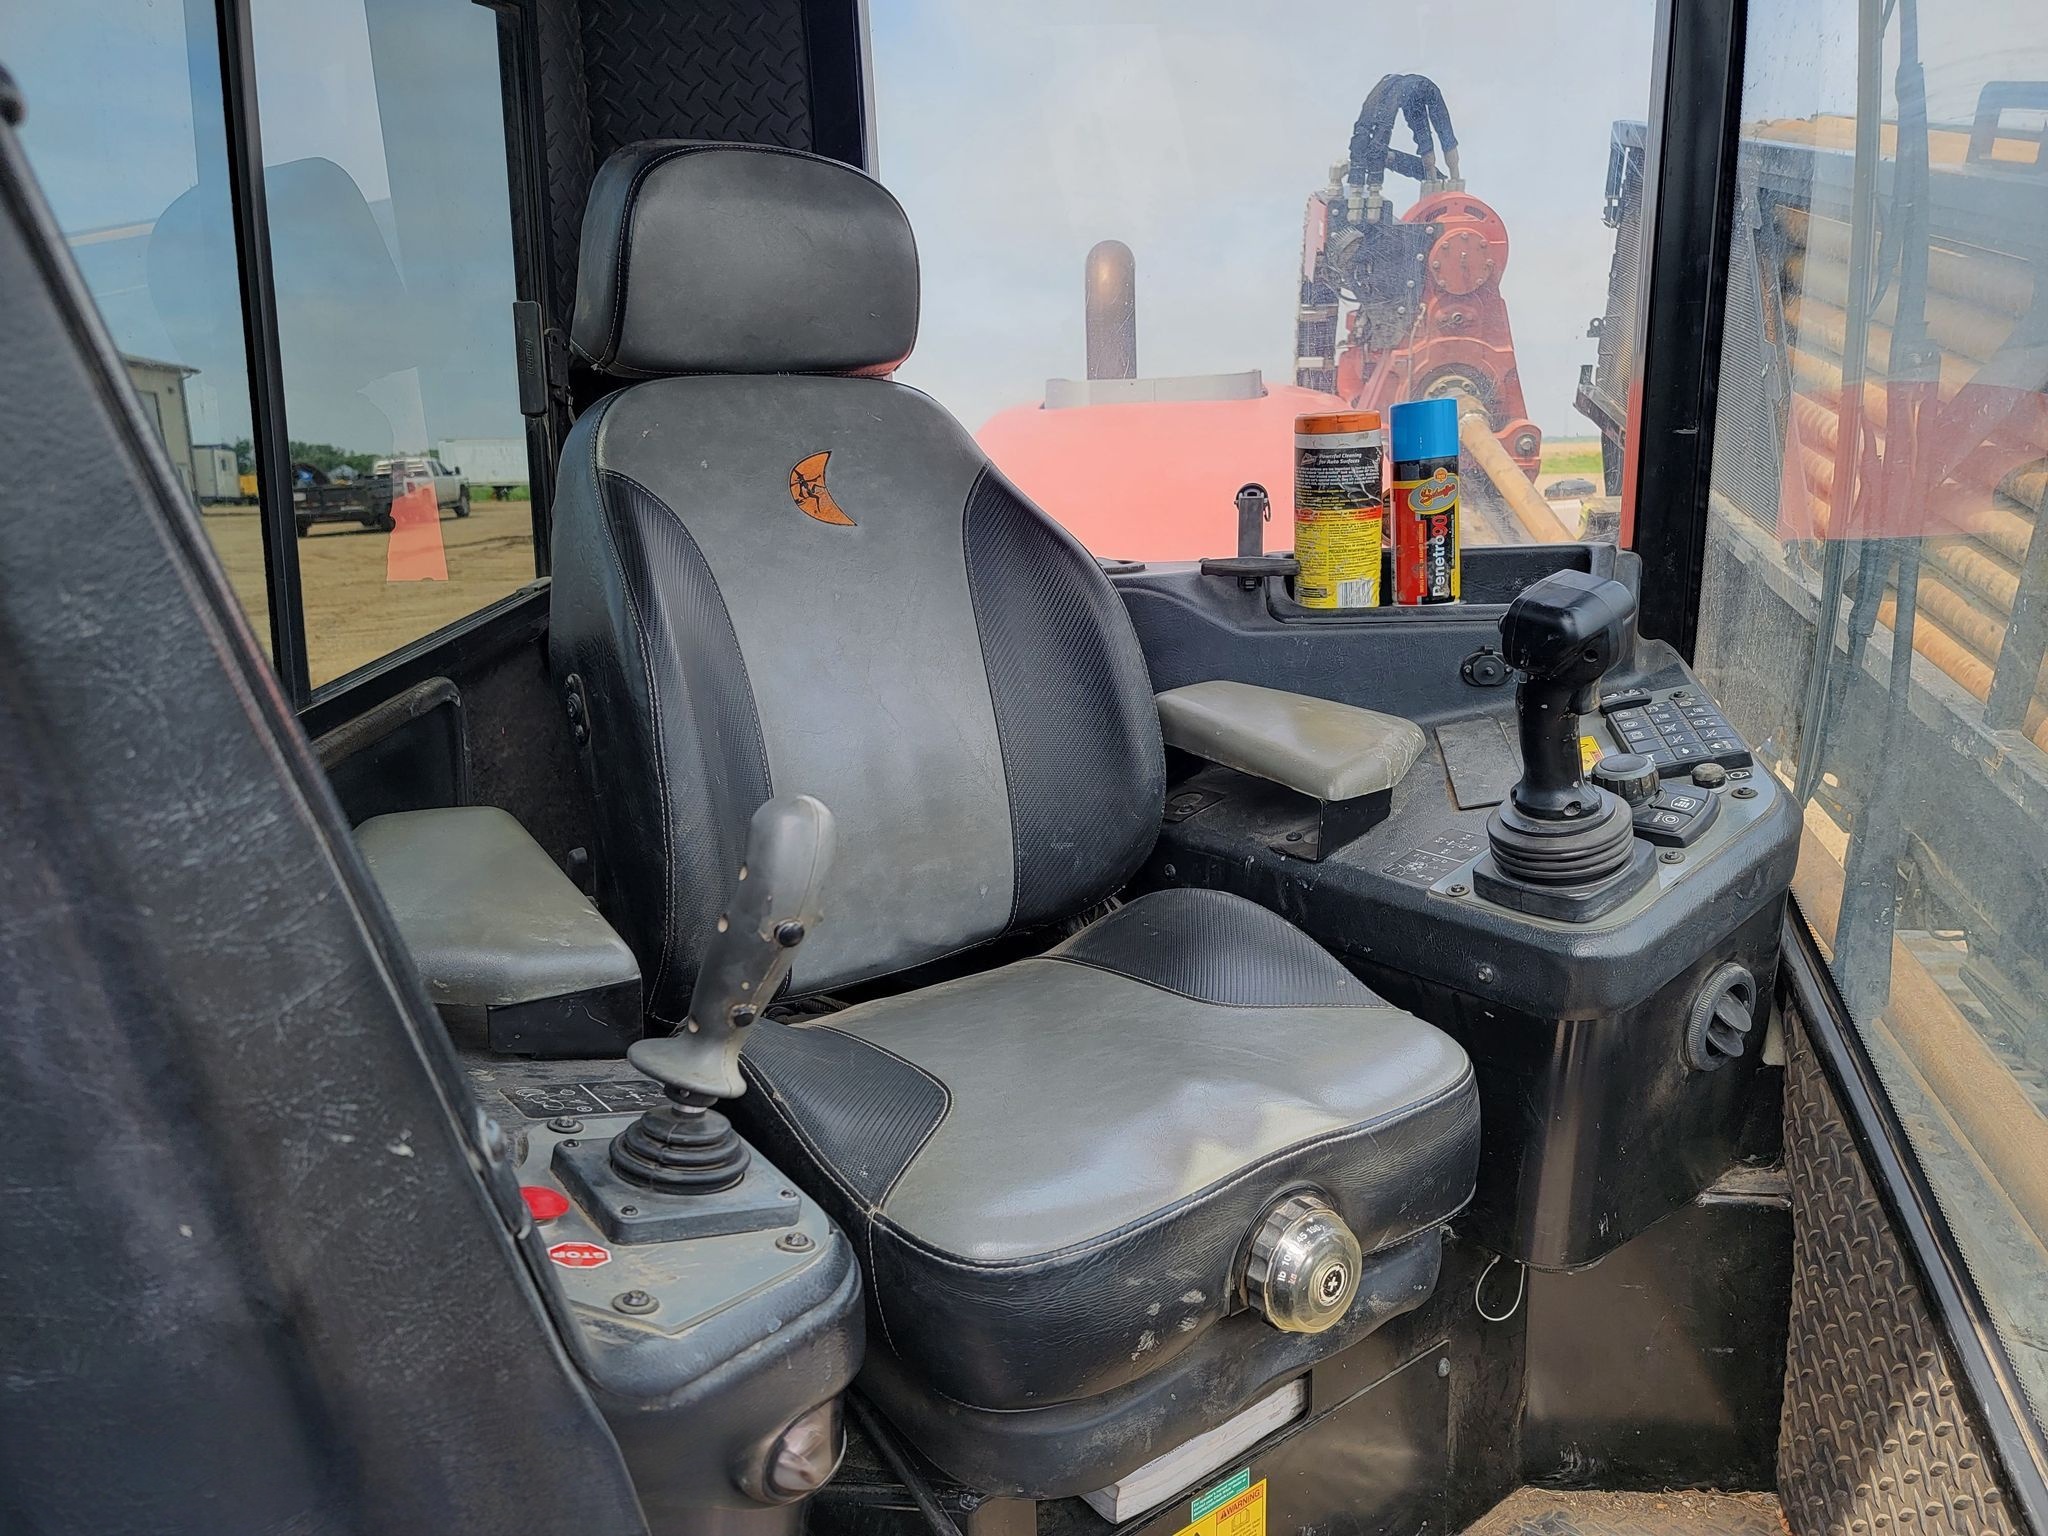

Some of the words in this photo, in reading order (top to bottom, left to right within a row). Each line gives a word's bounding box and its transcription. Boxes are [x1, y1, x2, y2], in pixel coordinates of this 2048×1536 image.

[1432, 514, 1449, 597] Penetro90
[551, 1251, 606, 1259] STOP
[1277, 1271, 1287, 1282] lb
[1226, 1489, 1260, 1515] WARNING
